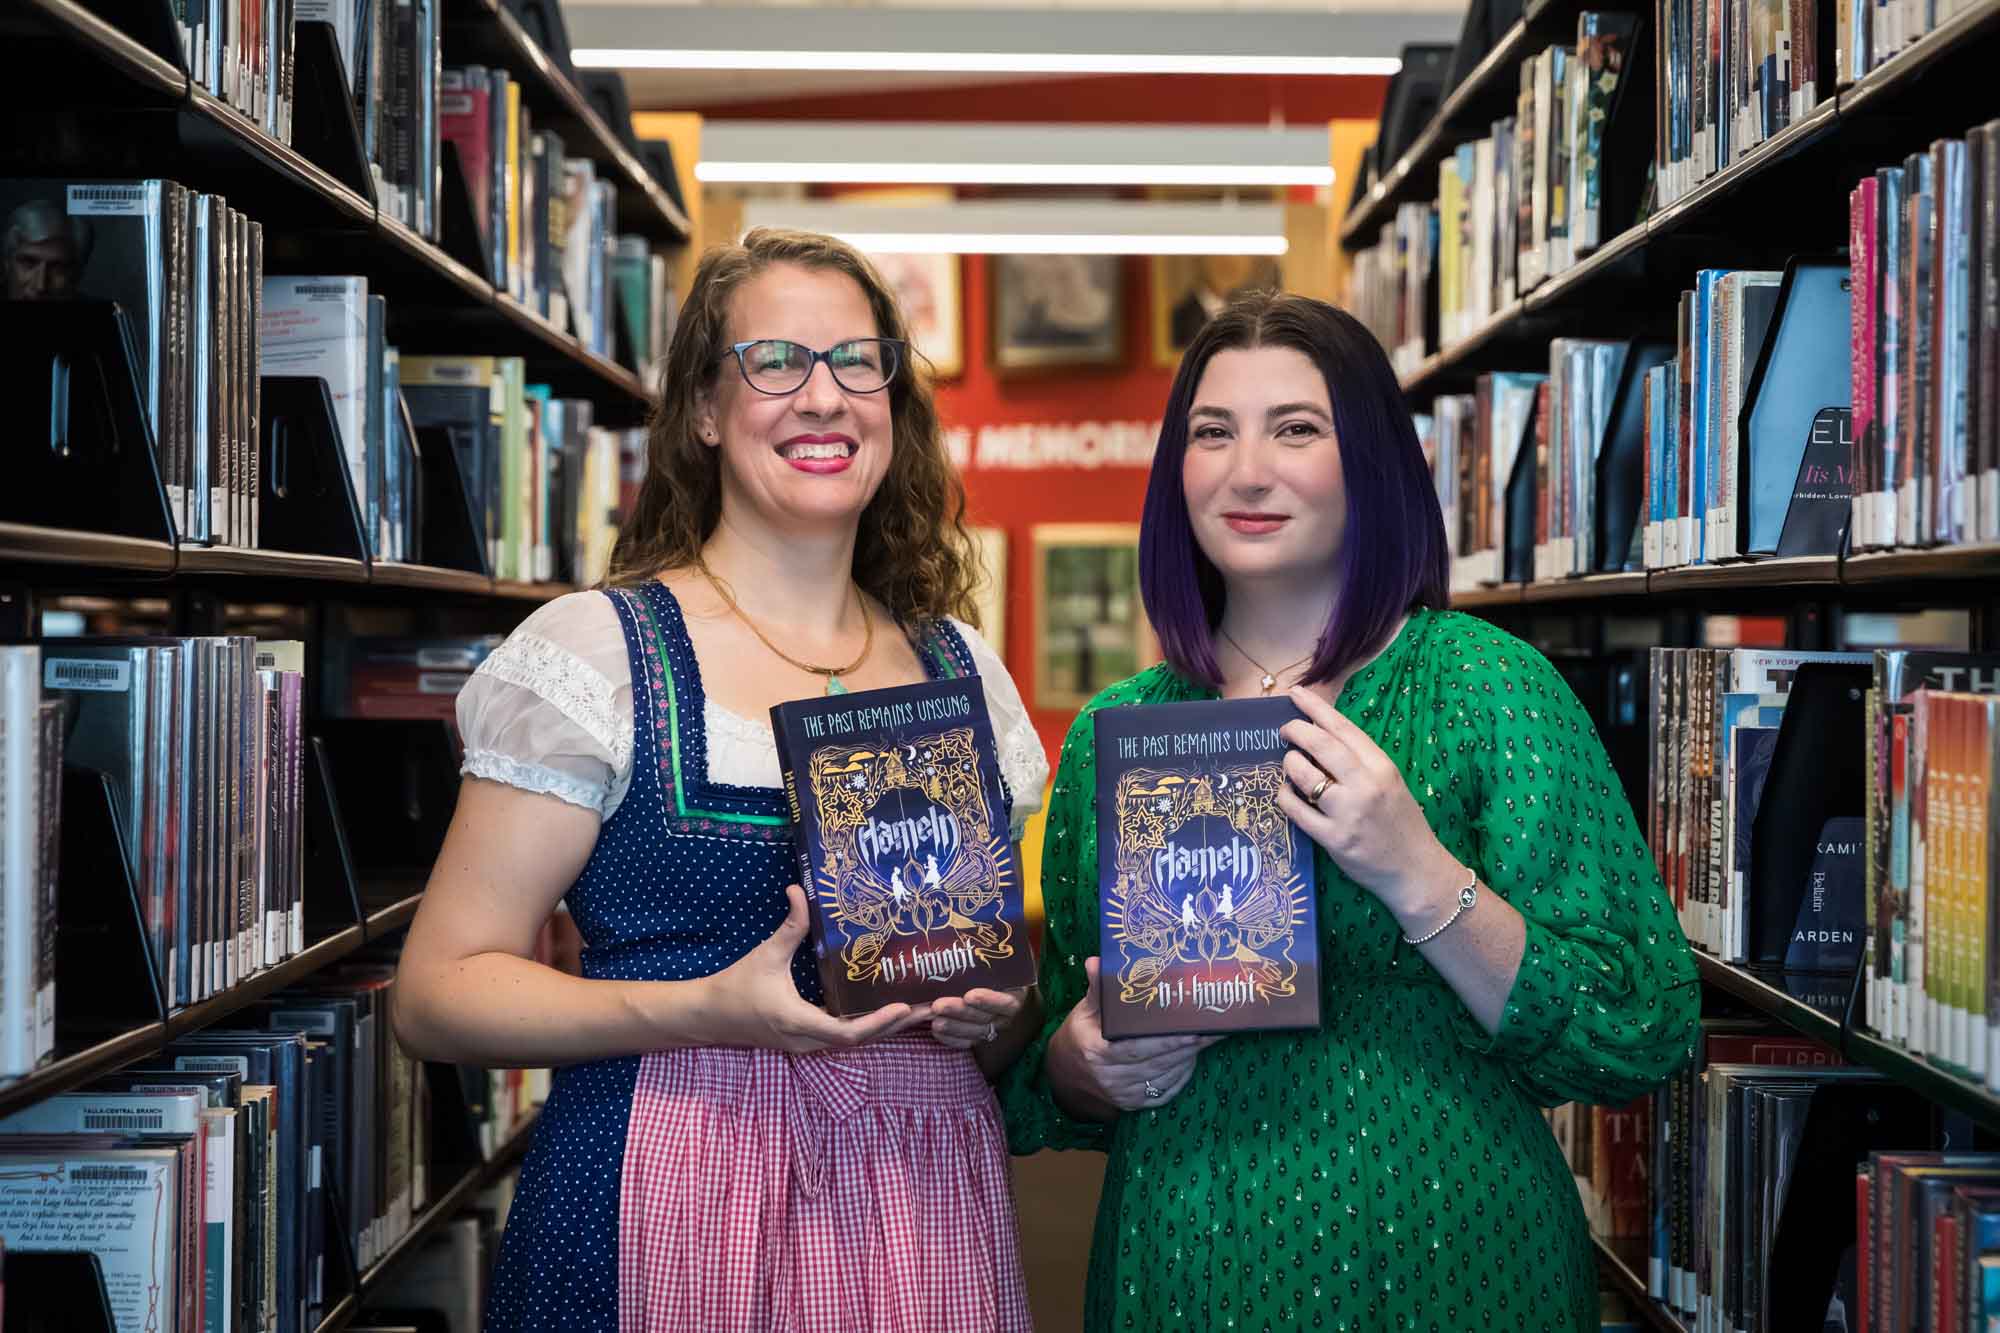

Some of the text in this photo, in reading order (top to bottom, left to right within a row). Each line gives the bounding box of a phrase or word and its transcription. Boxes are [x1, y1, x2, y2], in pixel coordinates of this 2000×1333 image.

[1795, 492, 1827, 500] rbidden
[803, 694, 970, 739] THE PAST REMAINS UNSUNG
[1117, 736, 1140, 760] THE
[1143, 733, 1171, 756] PAST
[1174, 730, 1231, 757] REMAINS
[783, 769, 801, 826] Hameln
[858, 805, 961, 868] Hameln
[1154, 836, 1260, 892] Hameln
[1791, 930, 1854, 943] ARDEN
